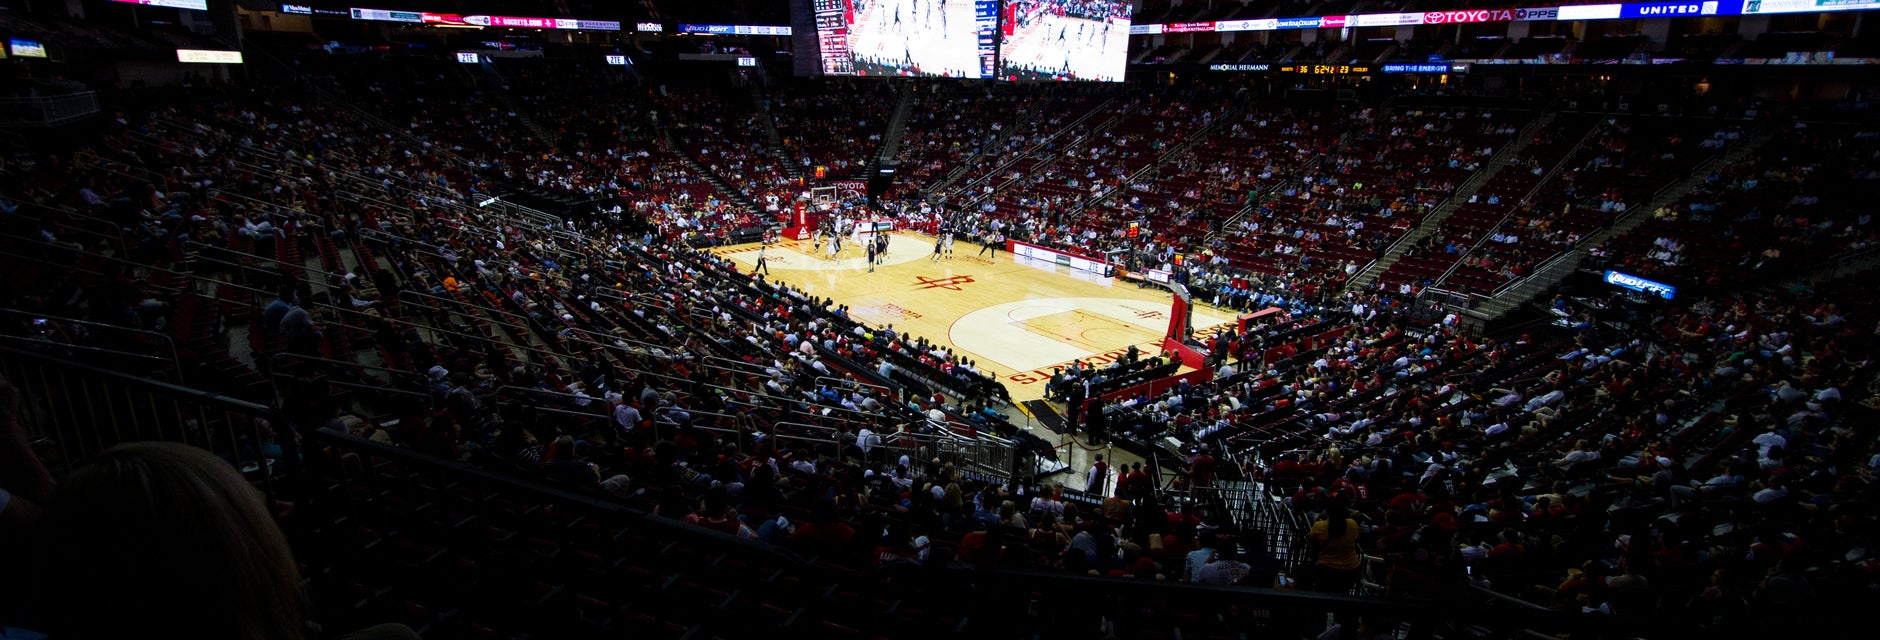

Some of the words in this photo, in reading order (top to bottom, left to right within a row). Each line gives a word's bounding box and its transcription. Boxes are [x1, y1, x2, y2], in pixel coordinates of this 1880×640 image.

[1528, 10, 1558, 18] PPS
[1640, 5, 1699, 15] UNITED
[1445, 10, 1512, 22] TOYOTA
[503, 18, 542, 27] ROCKETS.COM
[610, 56, 621, 64] ZTE
[1210, 63, 1237, 71] MEMORIAL
[1340, 65, 1349, 73] 23
[1023, 246, 1033, 256] ZTE
[1088, 261, 1099, 272] ZTE
